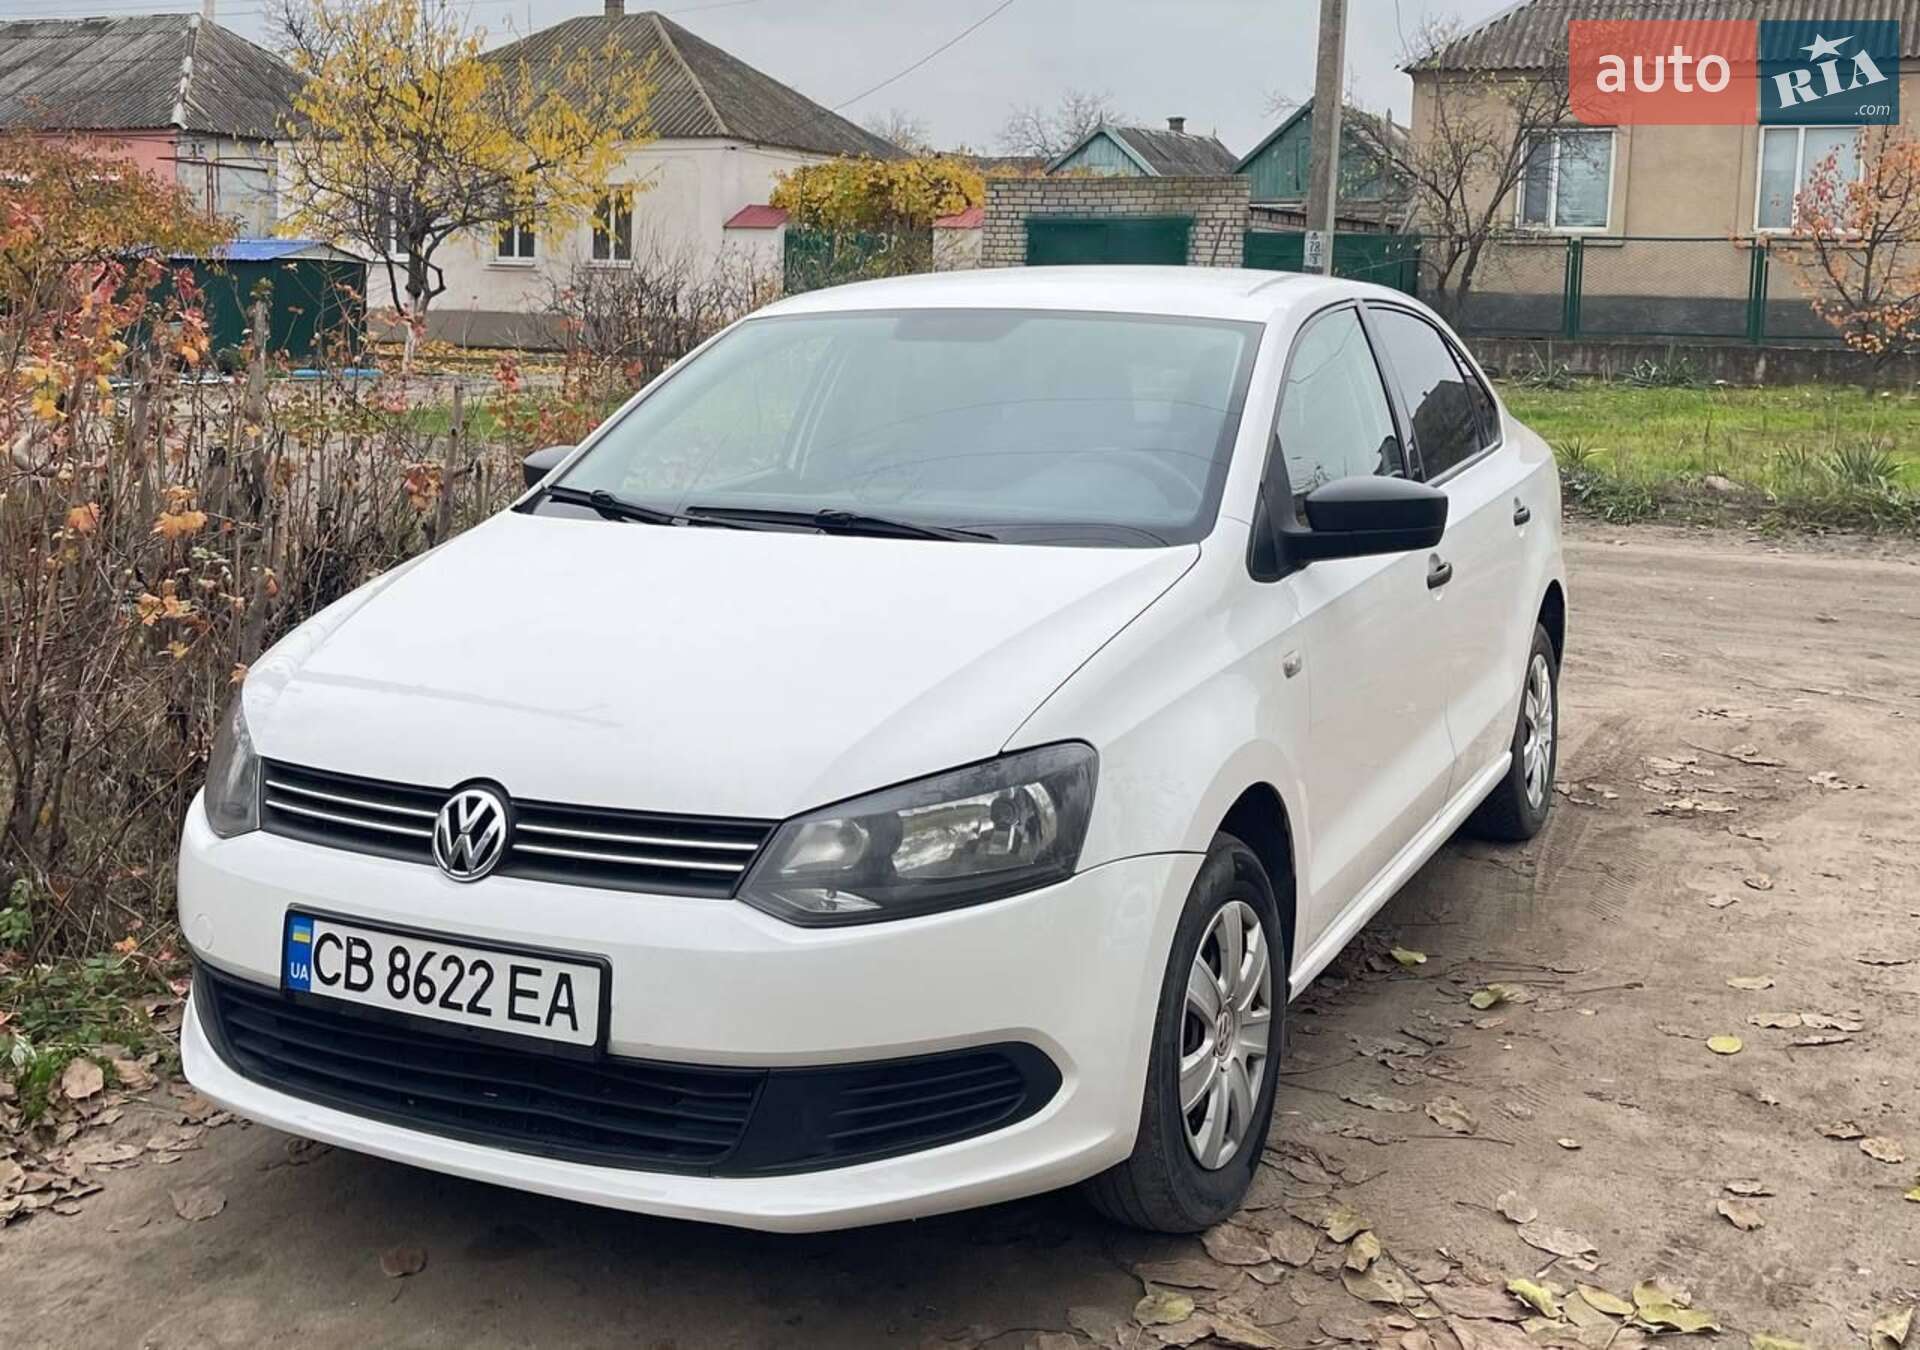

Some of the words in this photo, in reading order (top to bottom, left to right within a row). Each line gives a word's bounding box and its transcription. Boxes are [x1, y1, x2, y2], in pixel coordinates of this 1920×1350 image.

[290, 962, 309, 981] UA
[313, 932, 374, 992] CB
[387, 945, 494, 1017] 8622
[507, 963, 579, 1031] EA
